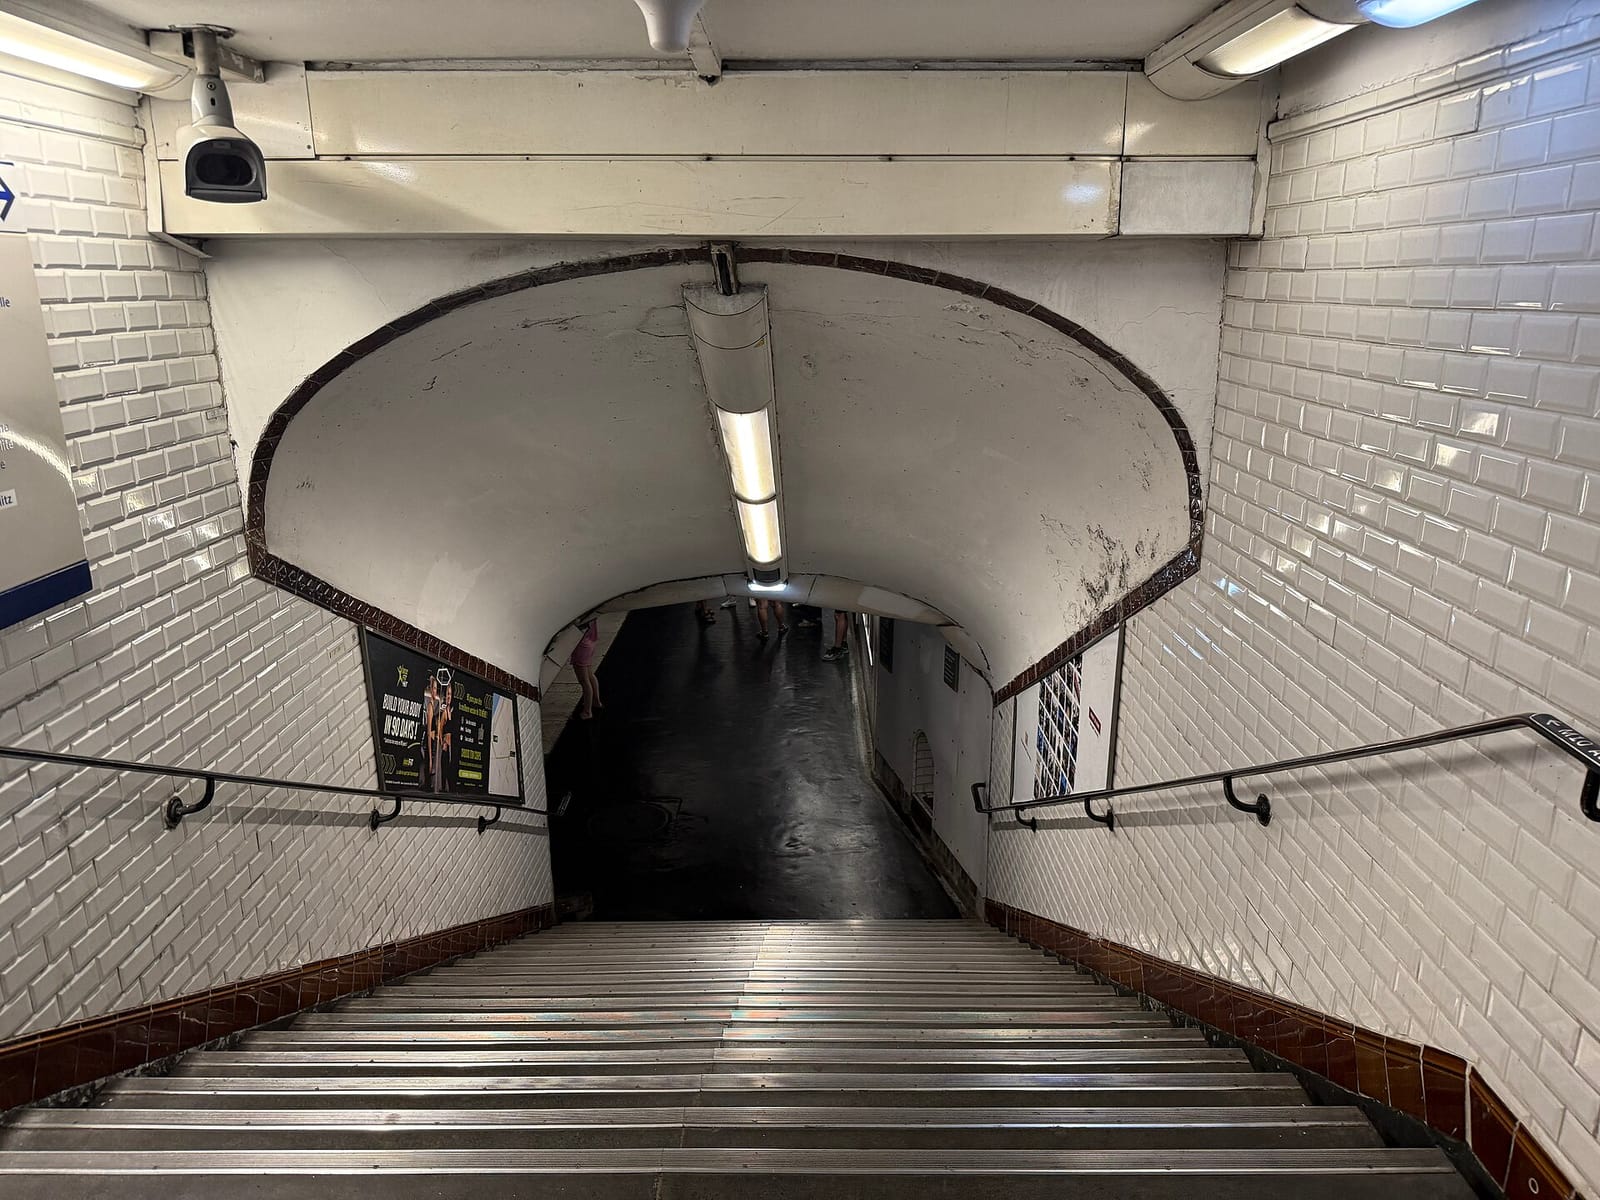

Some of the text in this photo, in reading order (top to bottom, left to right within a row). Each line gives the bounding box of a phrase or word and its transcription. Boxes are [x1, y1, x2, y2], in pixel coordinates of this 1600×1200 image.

[382, 693, 422, 718] BUILD YOUR BODY
[384, 714, 393, 735] IN
[391, 716, 401, 737] 90
